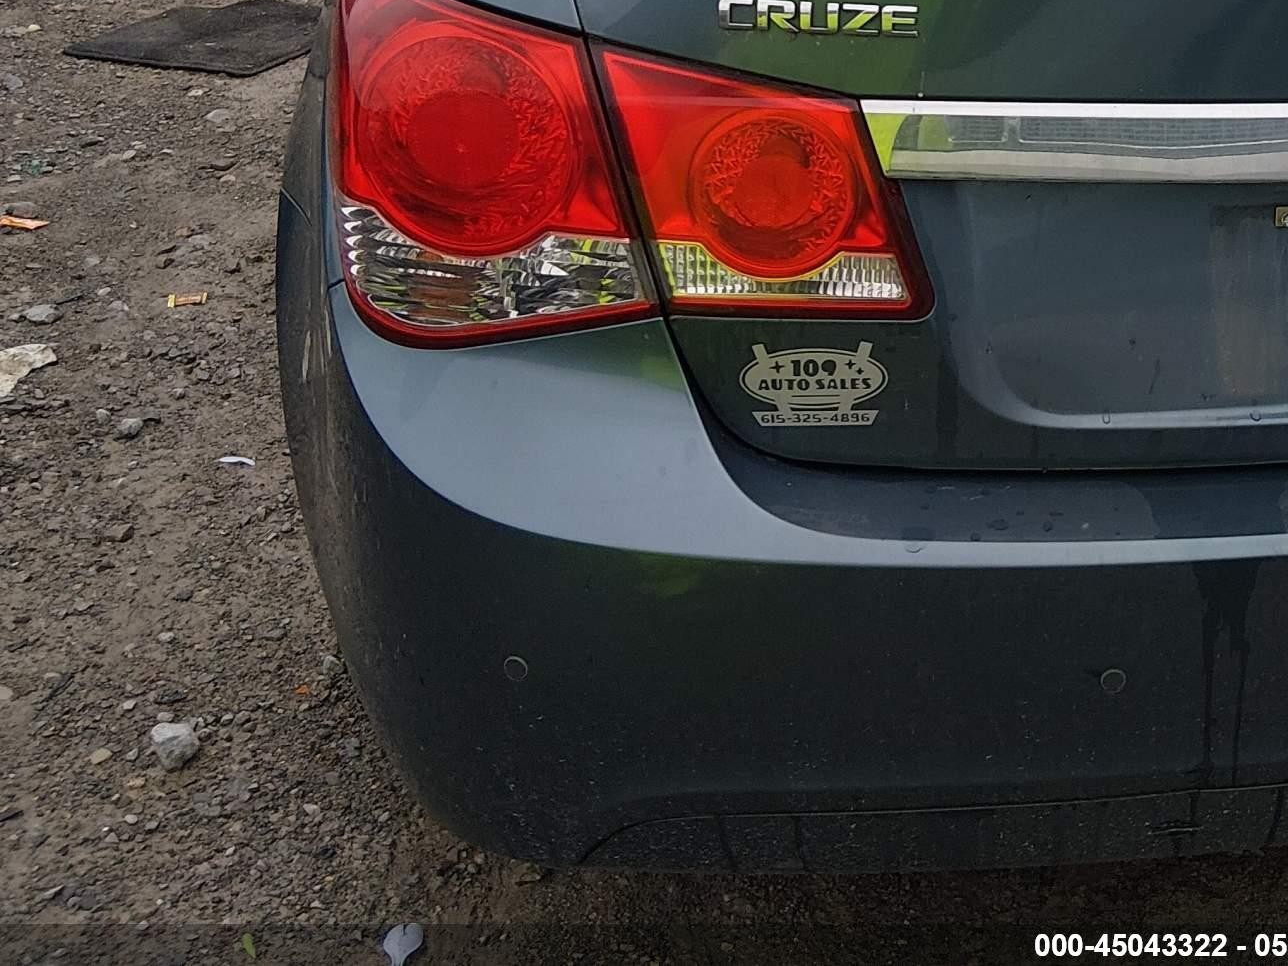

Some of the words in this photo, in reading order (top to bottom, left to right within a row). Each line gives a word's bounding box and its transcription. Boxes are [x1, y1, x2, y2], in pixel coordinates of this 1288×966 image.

[790, 359, 837, 377] 109
[758, 378, 810, 391] AUTO
[815, 377, 872, 390] SALES
[760, 412, 870, 424] 615-325-4896
